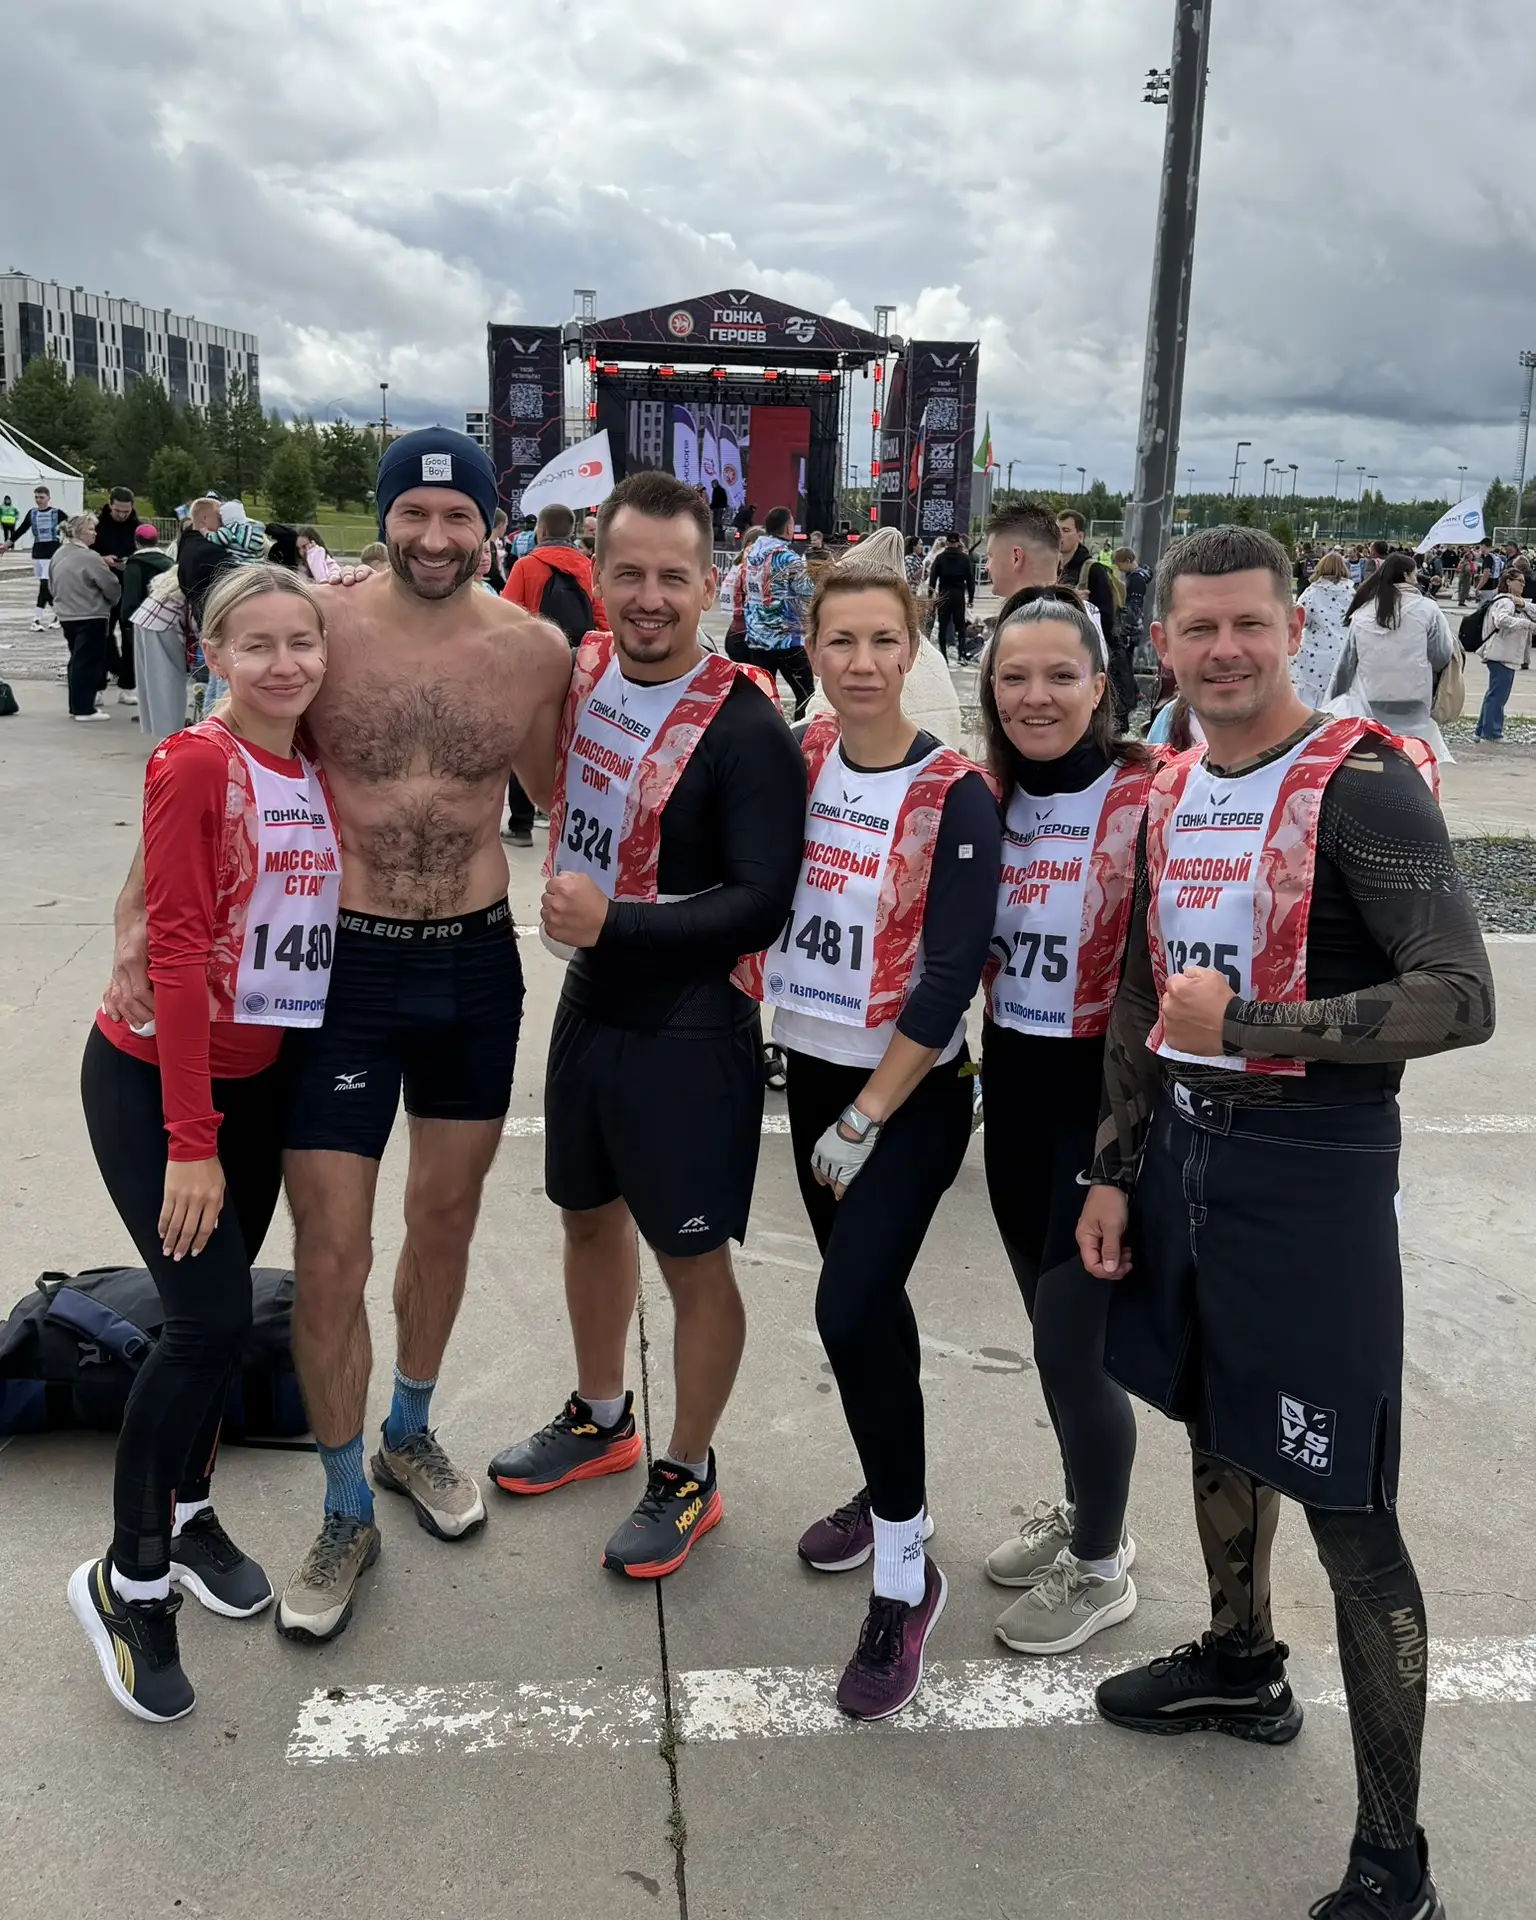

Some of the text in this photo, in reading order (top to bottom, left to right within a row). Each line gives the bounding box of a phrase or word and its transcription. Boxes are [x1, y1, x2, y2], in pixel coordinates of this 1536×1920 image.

[713, 309, 764, 325] ГОНКА
[709, 328, 767, 343] ГЕРОЕВ
[425, 457, 448, 466] Good
[428, 466, 445, 478] Boy
[930, 460, 954, 469] 2026
[588, 698, 617, 721] ГОНКА
[572, 734, 635, 782] МАССОВЫЙ
[581, 763, 612, 796] СТАРТ
[263, 808, 310, 823] ГОНКА
[842, 809, 890, 832] ГЕРОЕВ
[1175, 812, 1264, 828] ГОНКА ГЕРОЕВ
[1037, 823, 1090, 837] ГЕРОЕВ
[1164, 851, 1254, 882] МАССОВЫЙ
[806, 865, 849, 895] СТАРТ
[1176, 885, 1224, 910] СТАРТ
[337, 914, 463, 940] NELEUS PRO
[253, 923, 332, 972] 1480
[789, 982, 863, 1011] ГАЗПРОМБАНК
[1280, 1439, 1329, 1468] ZAP
[675, 1496, 703, 1535] HOKA
[1388, 1606, 1427, 1689] VENUM
